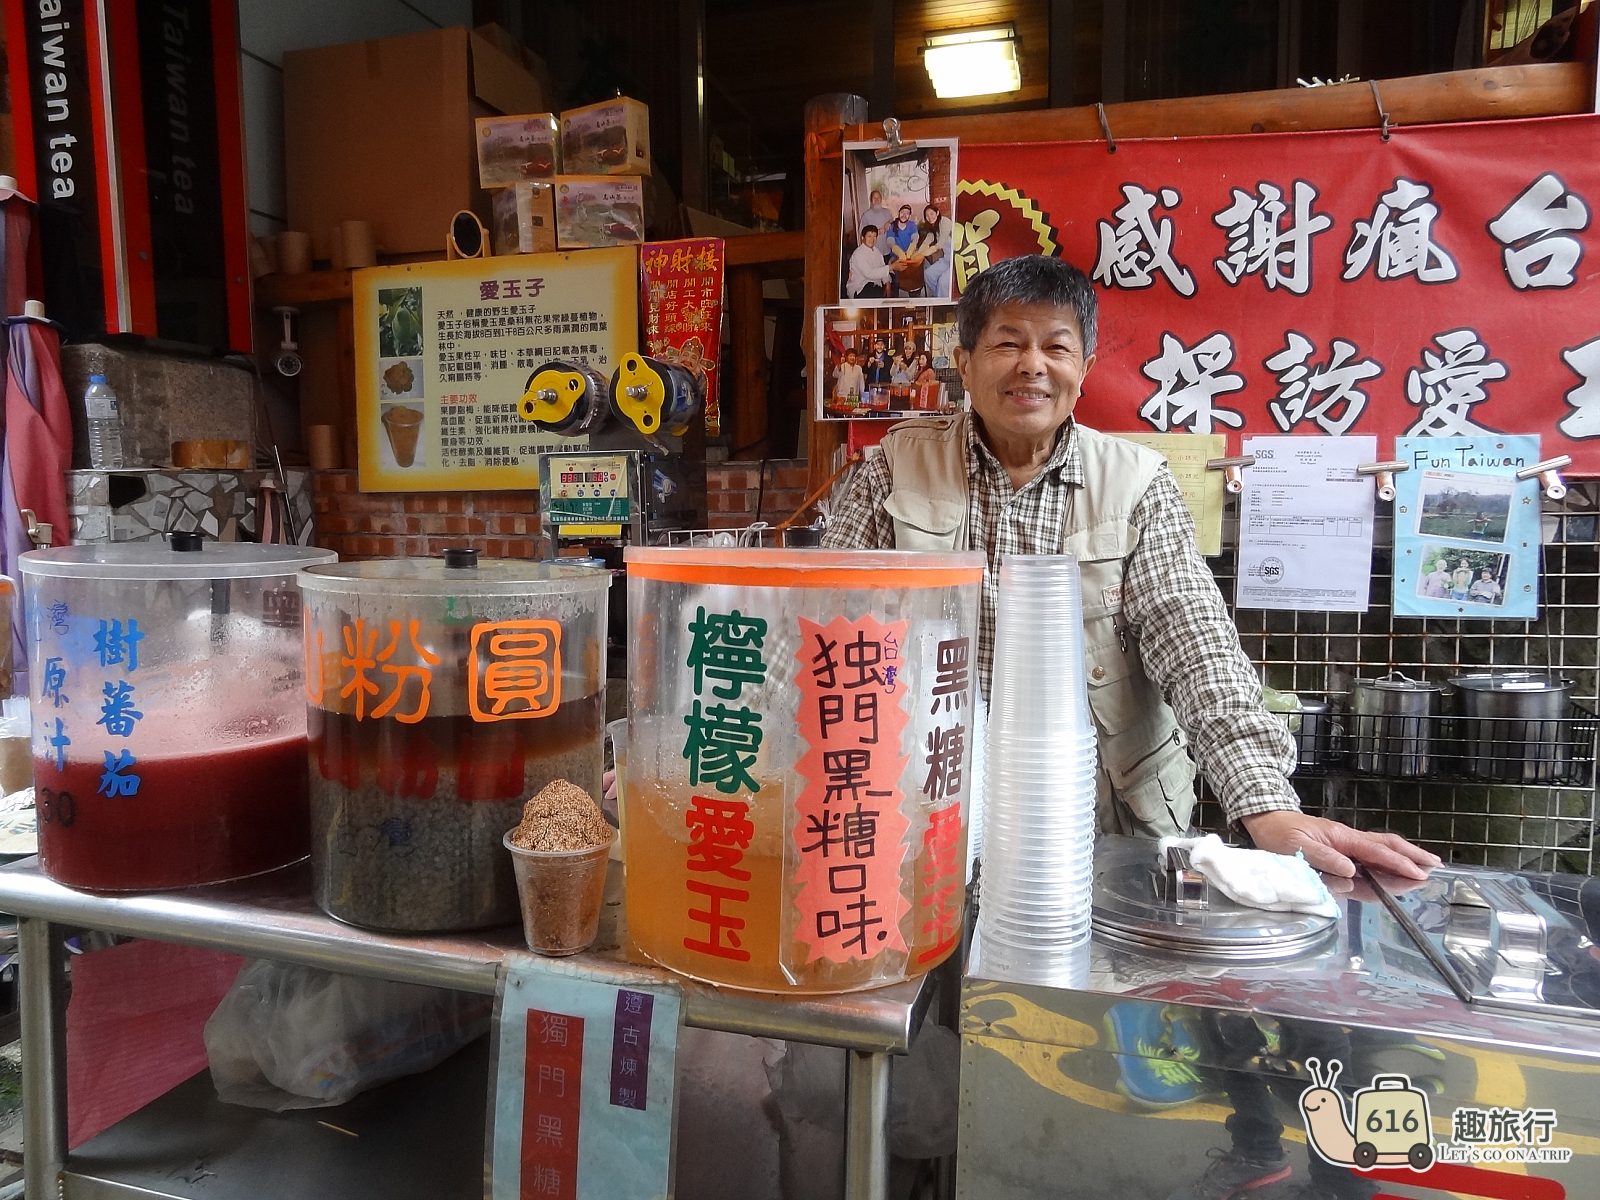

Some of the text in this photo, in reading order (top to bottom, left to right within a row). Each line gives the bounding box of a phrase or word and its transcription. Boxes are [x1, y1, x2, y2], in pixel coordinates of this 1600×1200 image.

[49, 133, 78, 199] tea
[171, 154, 197, 214] tea
[1091, 172, 1590, 298] 感謝瘋台
[479, 277, 546, 301] 愛玉子
[440, 393, 478, 405] 主要功效
[1255, 449, 1274, 459] SGS
[1413, 445, 1525, 469] Fun Taiwan
[1264, 566, 1279, 575] SGS
[42, 656, 71, 772] 原汁
[92, 618, 145, 798] 樹蕃茄
[533, 1014, 568, 1196] 獨門黑糖
